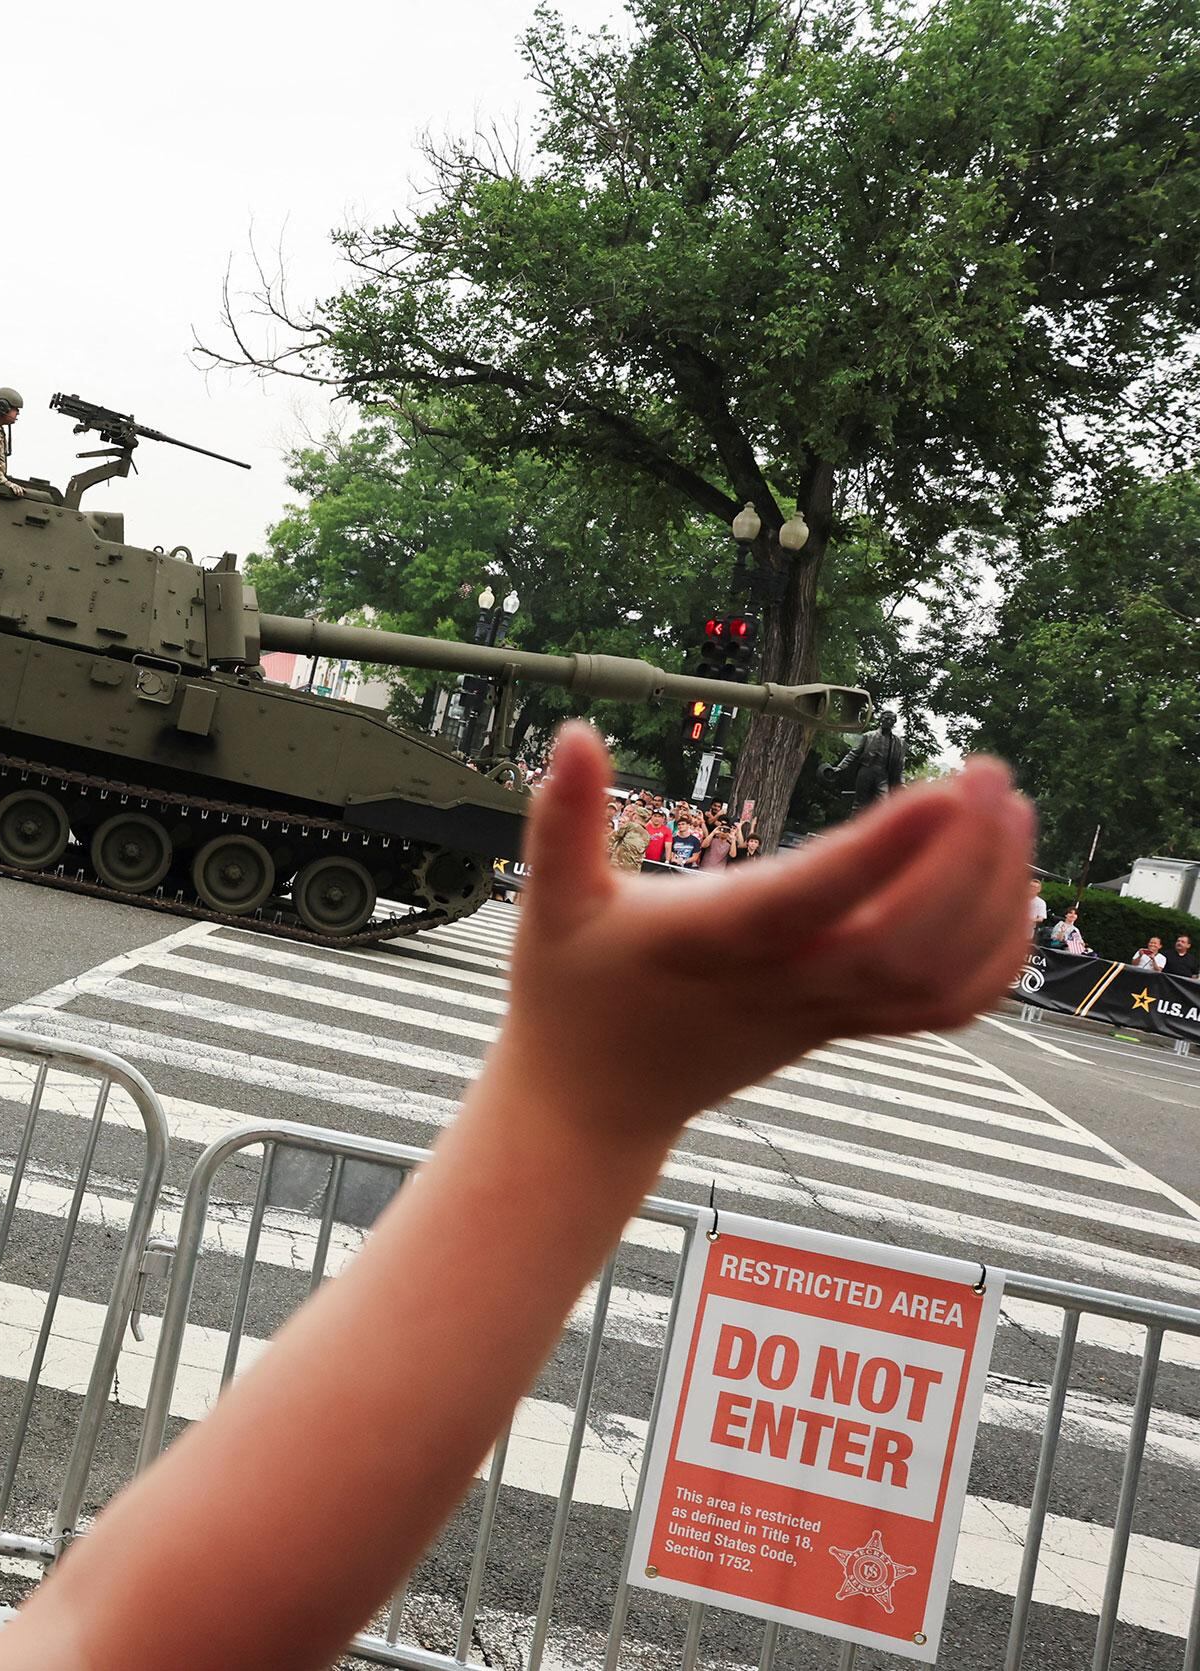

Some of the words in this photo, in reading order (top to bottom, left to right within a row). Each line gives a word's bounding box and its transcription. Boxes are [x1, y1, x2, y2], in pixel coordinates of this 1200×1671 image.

[692, 722, 702, 739] 0
[1157, 999, 1184, 1018] U.S.
[719, 1253, 883, 1311] RESTRICTED
[889, 1291, 964, 1329] AREA
[712, 1323, 800, 1391] DO
[810, 1345, 943, 1423] NOT
[710, 1391, 914, 1489] ENTER
[671, 1506, 688, 1519] as
[691, 1510, 741, 1532] defined
[744, 1521, 757, 1536] in
[761, 1525, 790, 1544] Title
[794, 1535, 814, 1552] 18,
[676, 1486, 704, 1504] This
[706, 1496, 736, 1512] area
[740, 1502, 752, 1516] is
[755, 1508, 822, 1533] restricted
[665, 1539, 714, 1563] Section
[719, 1553, 753, 1573] 1752.
[668, 1521, 711, 1543] United
[714, 1533, 757, 1554] States
[760, 1544, 798, 1567] Code,
[853, 1549, 891, 1565] SECRET
[849, 1575, 889, 1593] SERVICE
